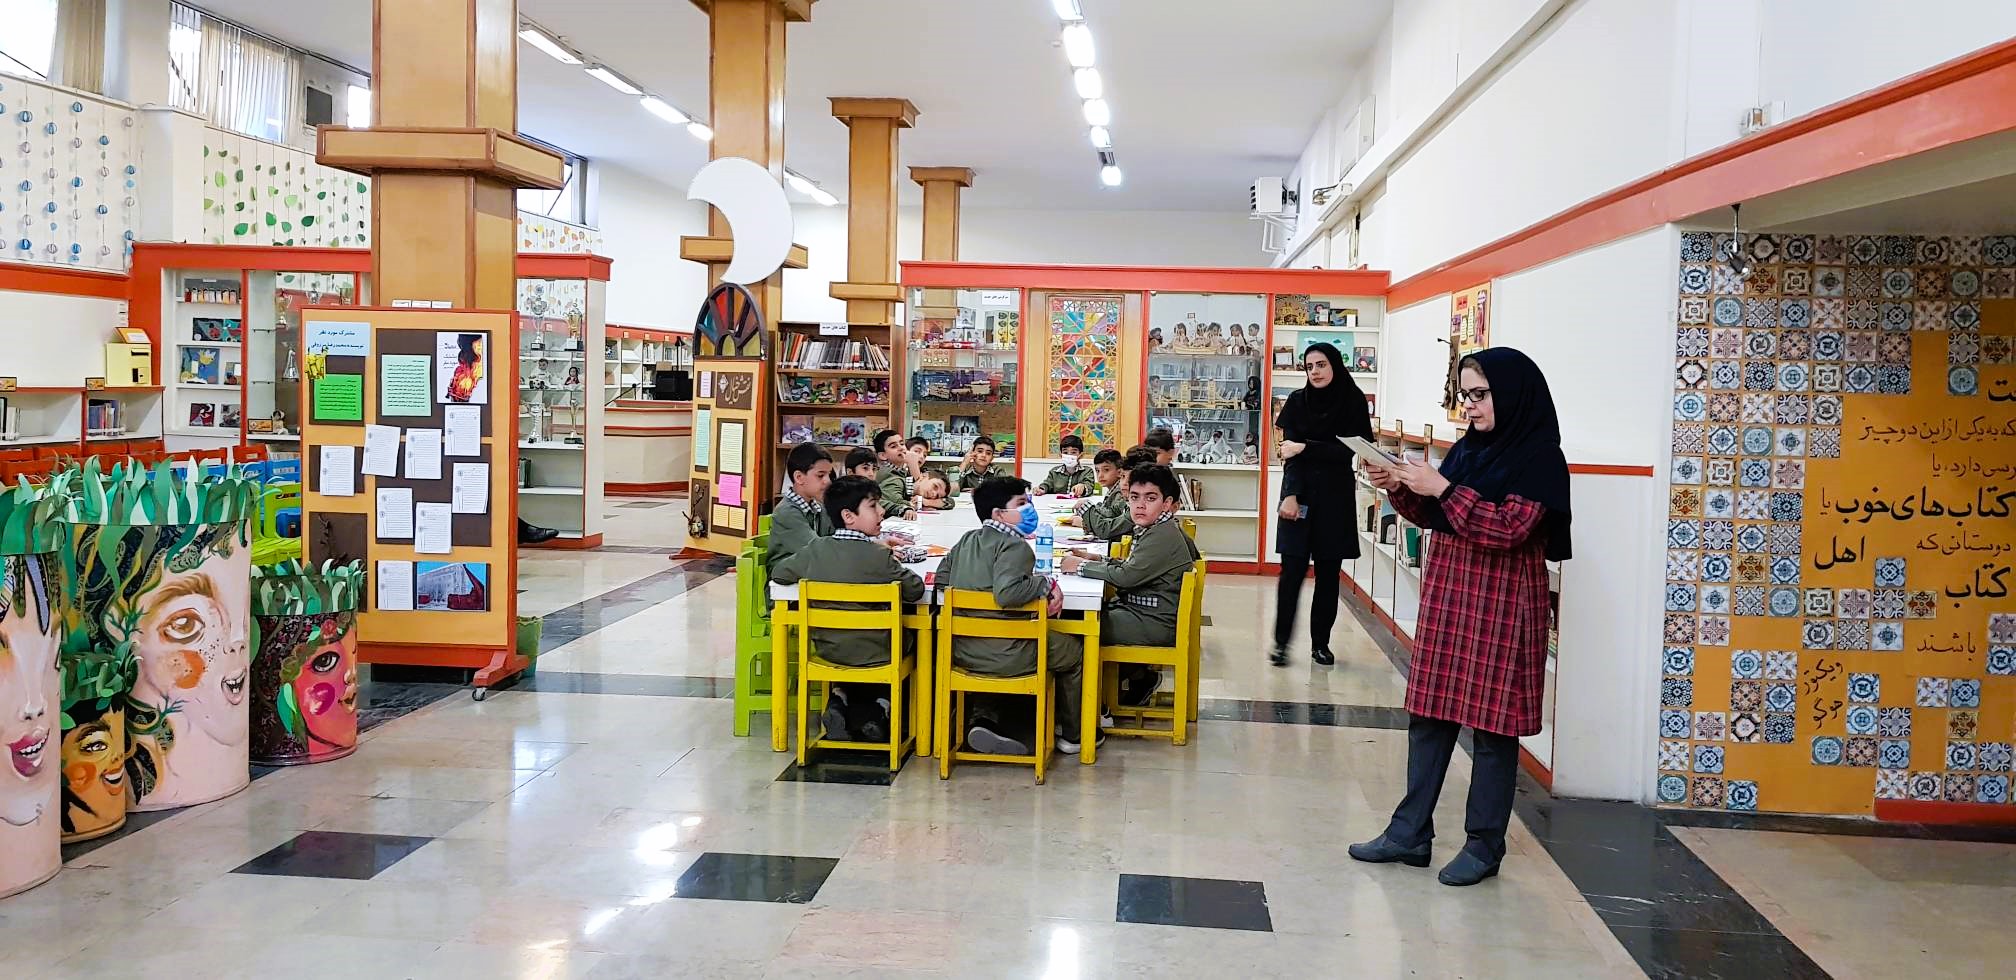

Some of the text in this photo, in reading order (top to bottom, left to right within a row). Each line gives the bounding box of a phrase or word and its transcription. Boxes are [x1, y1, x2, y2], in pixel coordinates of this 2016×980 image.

[1858, 416, 1898, 444] چیز
[1820, 487, 1831, 515] یا
[1835, 487, 1890, 523] خوب
[1814, 531, 2011, 570] دوستانی که اهل
[1945, 562, 2011, 608] کتاب
[1917, 631, 1976, 661] باشند
[1803, 659, 1844, 695] ویکتور
